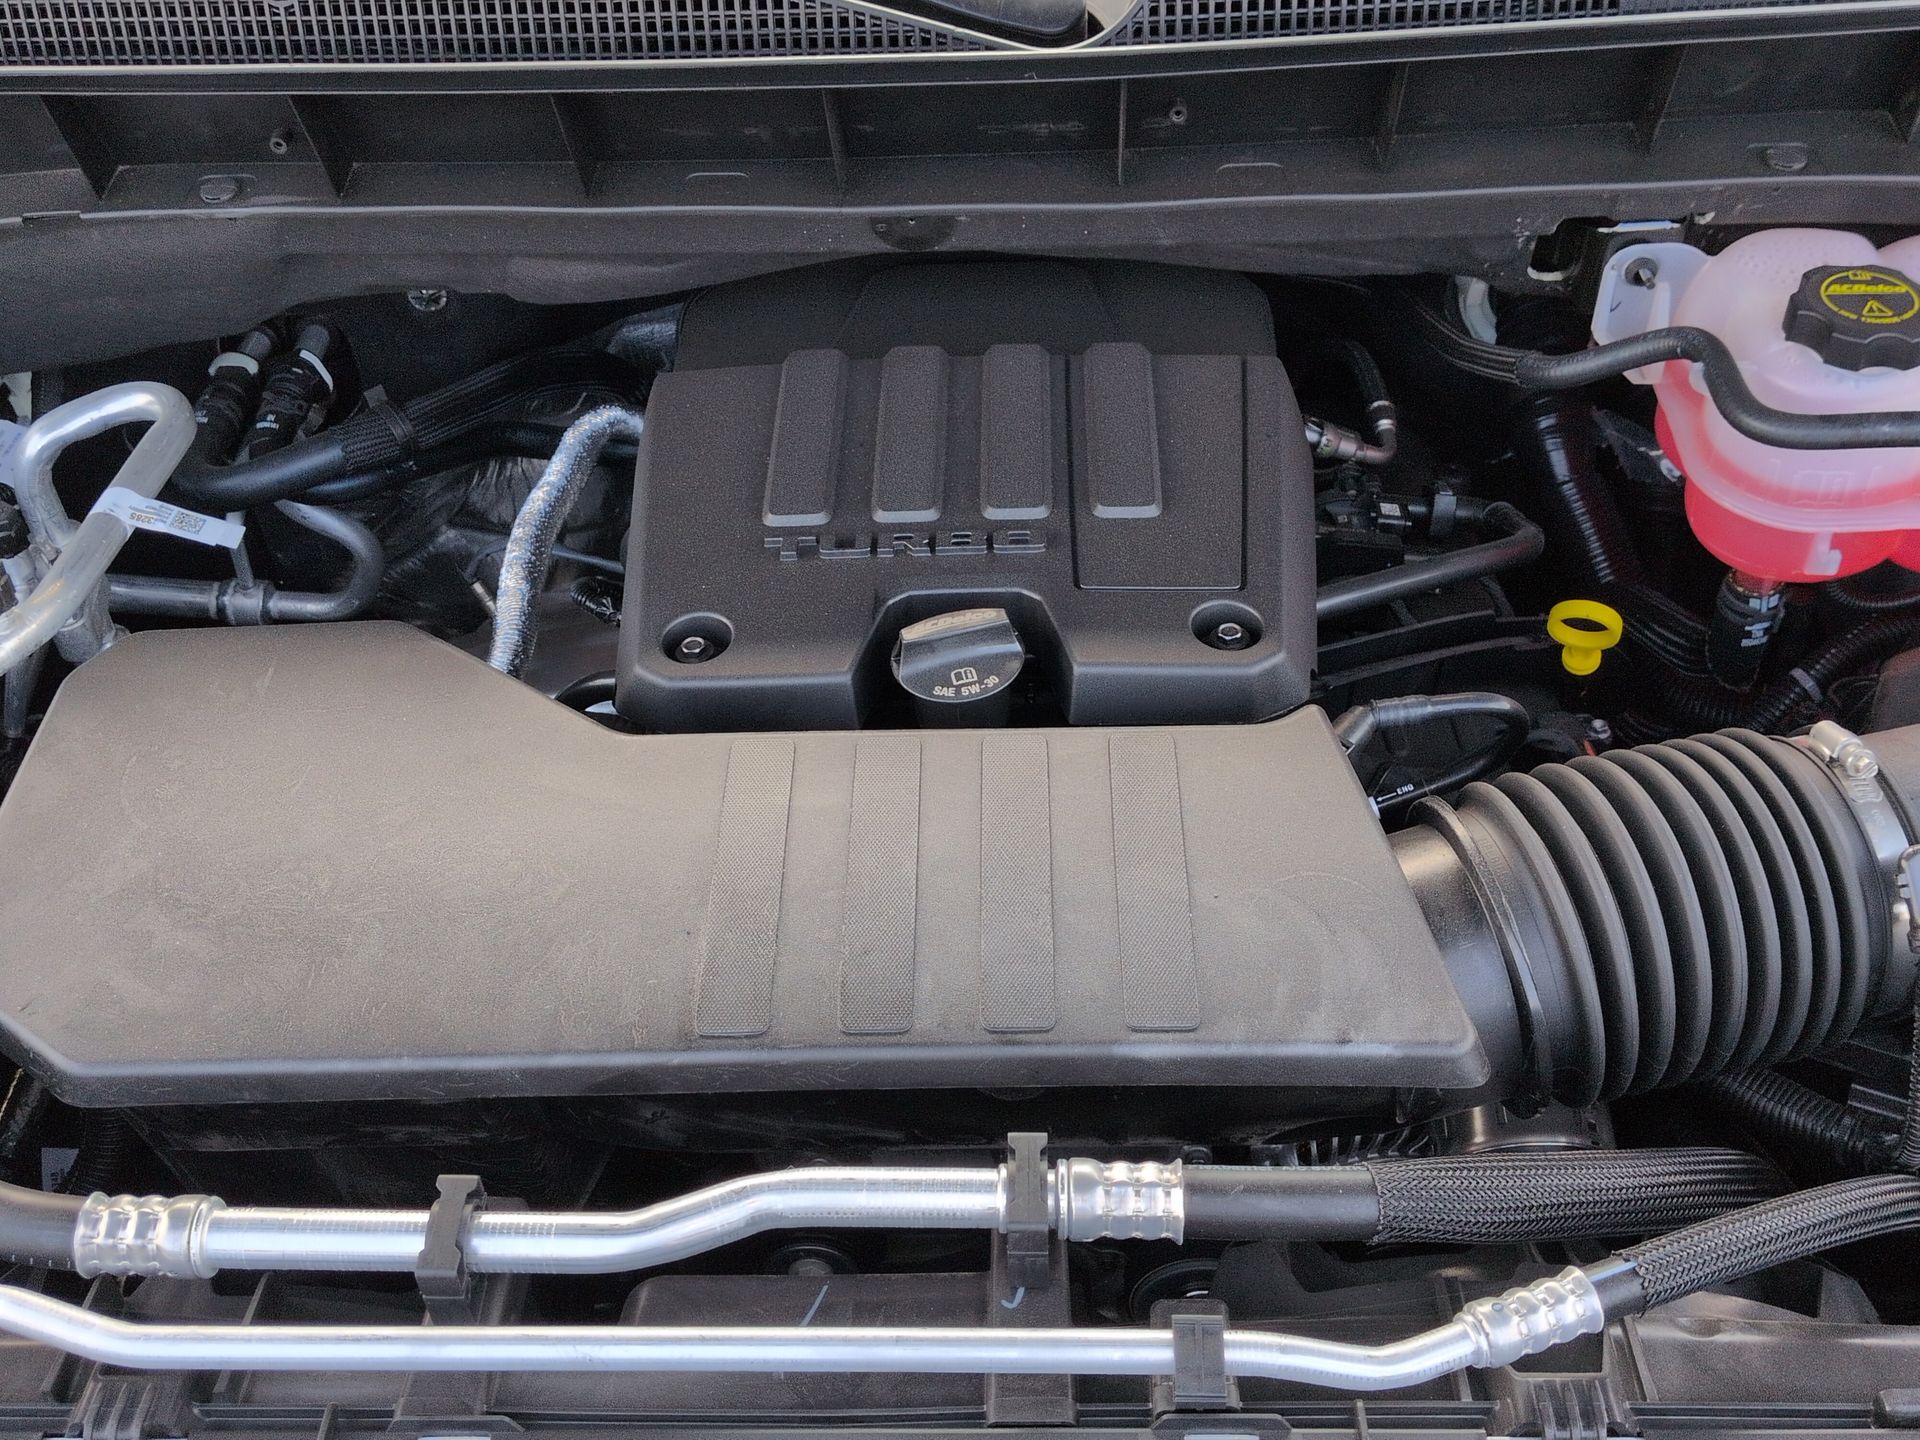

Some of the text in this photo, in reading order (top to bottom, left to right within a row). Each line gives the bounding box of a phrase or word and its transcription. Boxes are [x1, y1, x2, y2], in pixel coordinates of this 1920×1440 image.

[764, 531, 1046, 561] TURBO
[908, 611, 997, 632] ACDelco
[933, 675, 999, 696] SAE 5W-30
